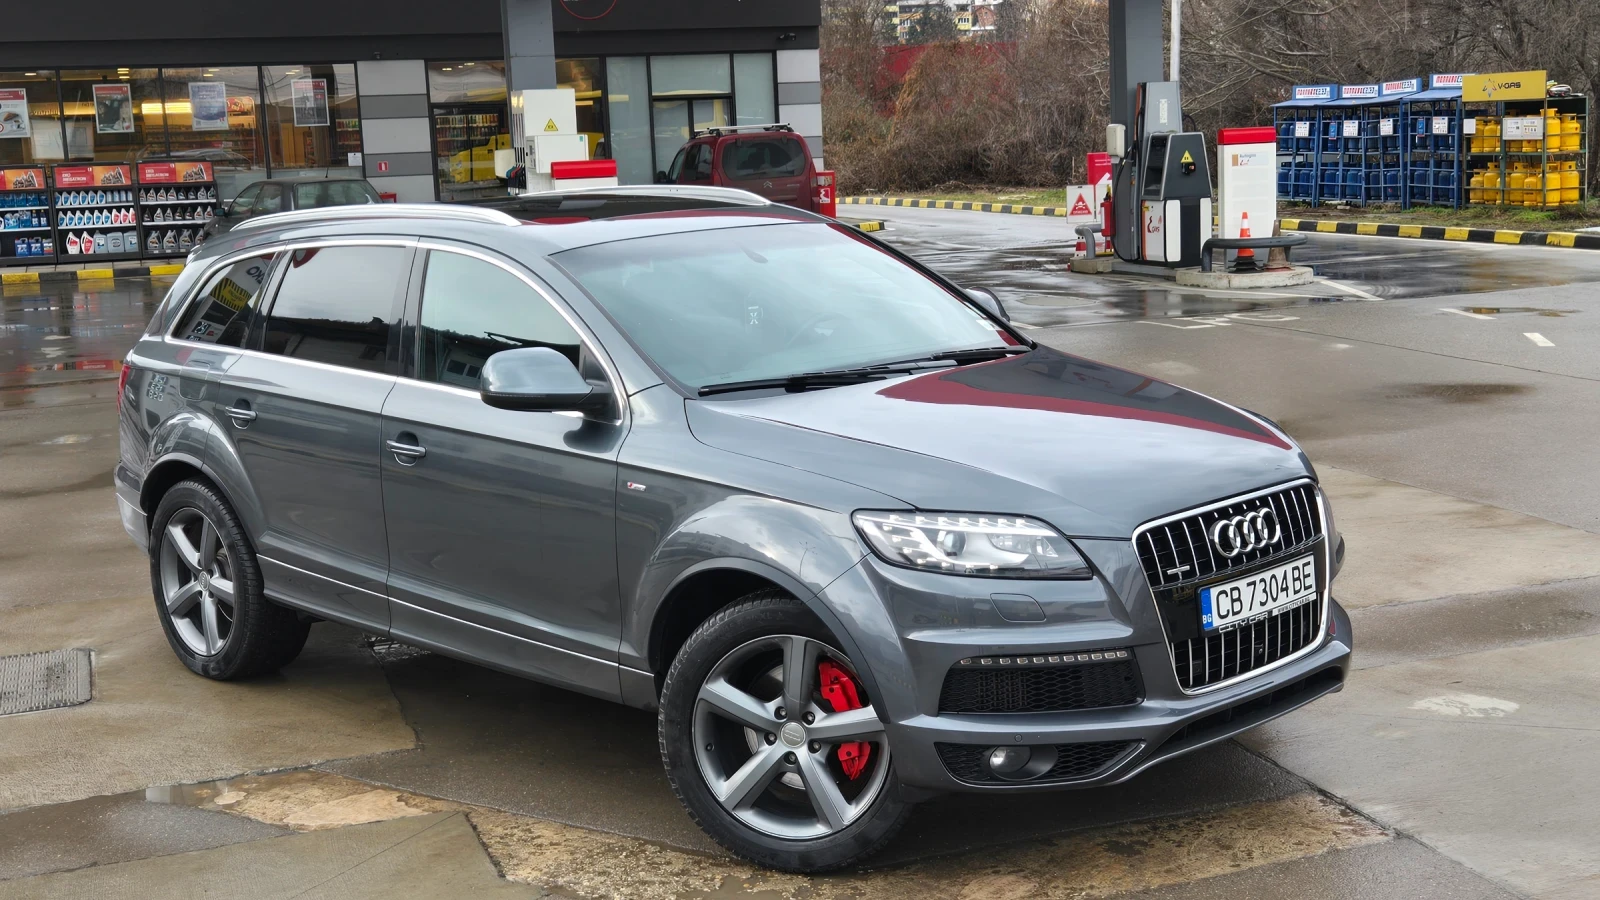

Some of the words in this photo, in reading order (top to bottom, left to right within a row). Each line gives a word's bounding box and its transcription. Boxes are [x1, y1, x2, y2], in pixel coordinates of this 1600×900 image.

[1498, 82, 1521, 90] V-GAS
[1215, 585, 1243, 620] CB
[1246, 569, 1289, 612] 7304
[1291, 561, 1313, 595] BE
[1202, 613, 1212, 624] BG
[1218, 619, 1248, 633] CITY
[1248, 612, 1268, 624] CAR
